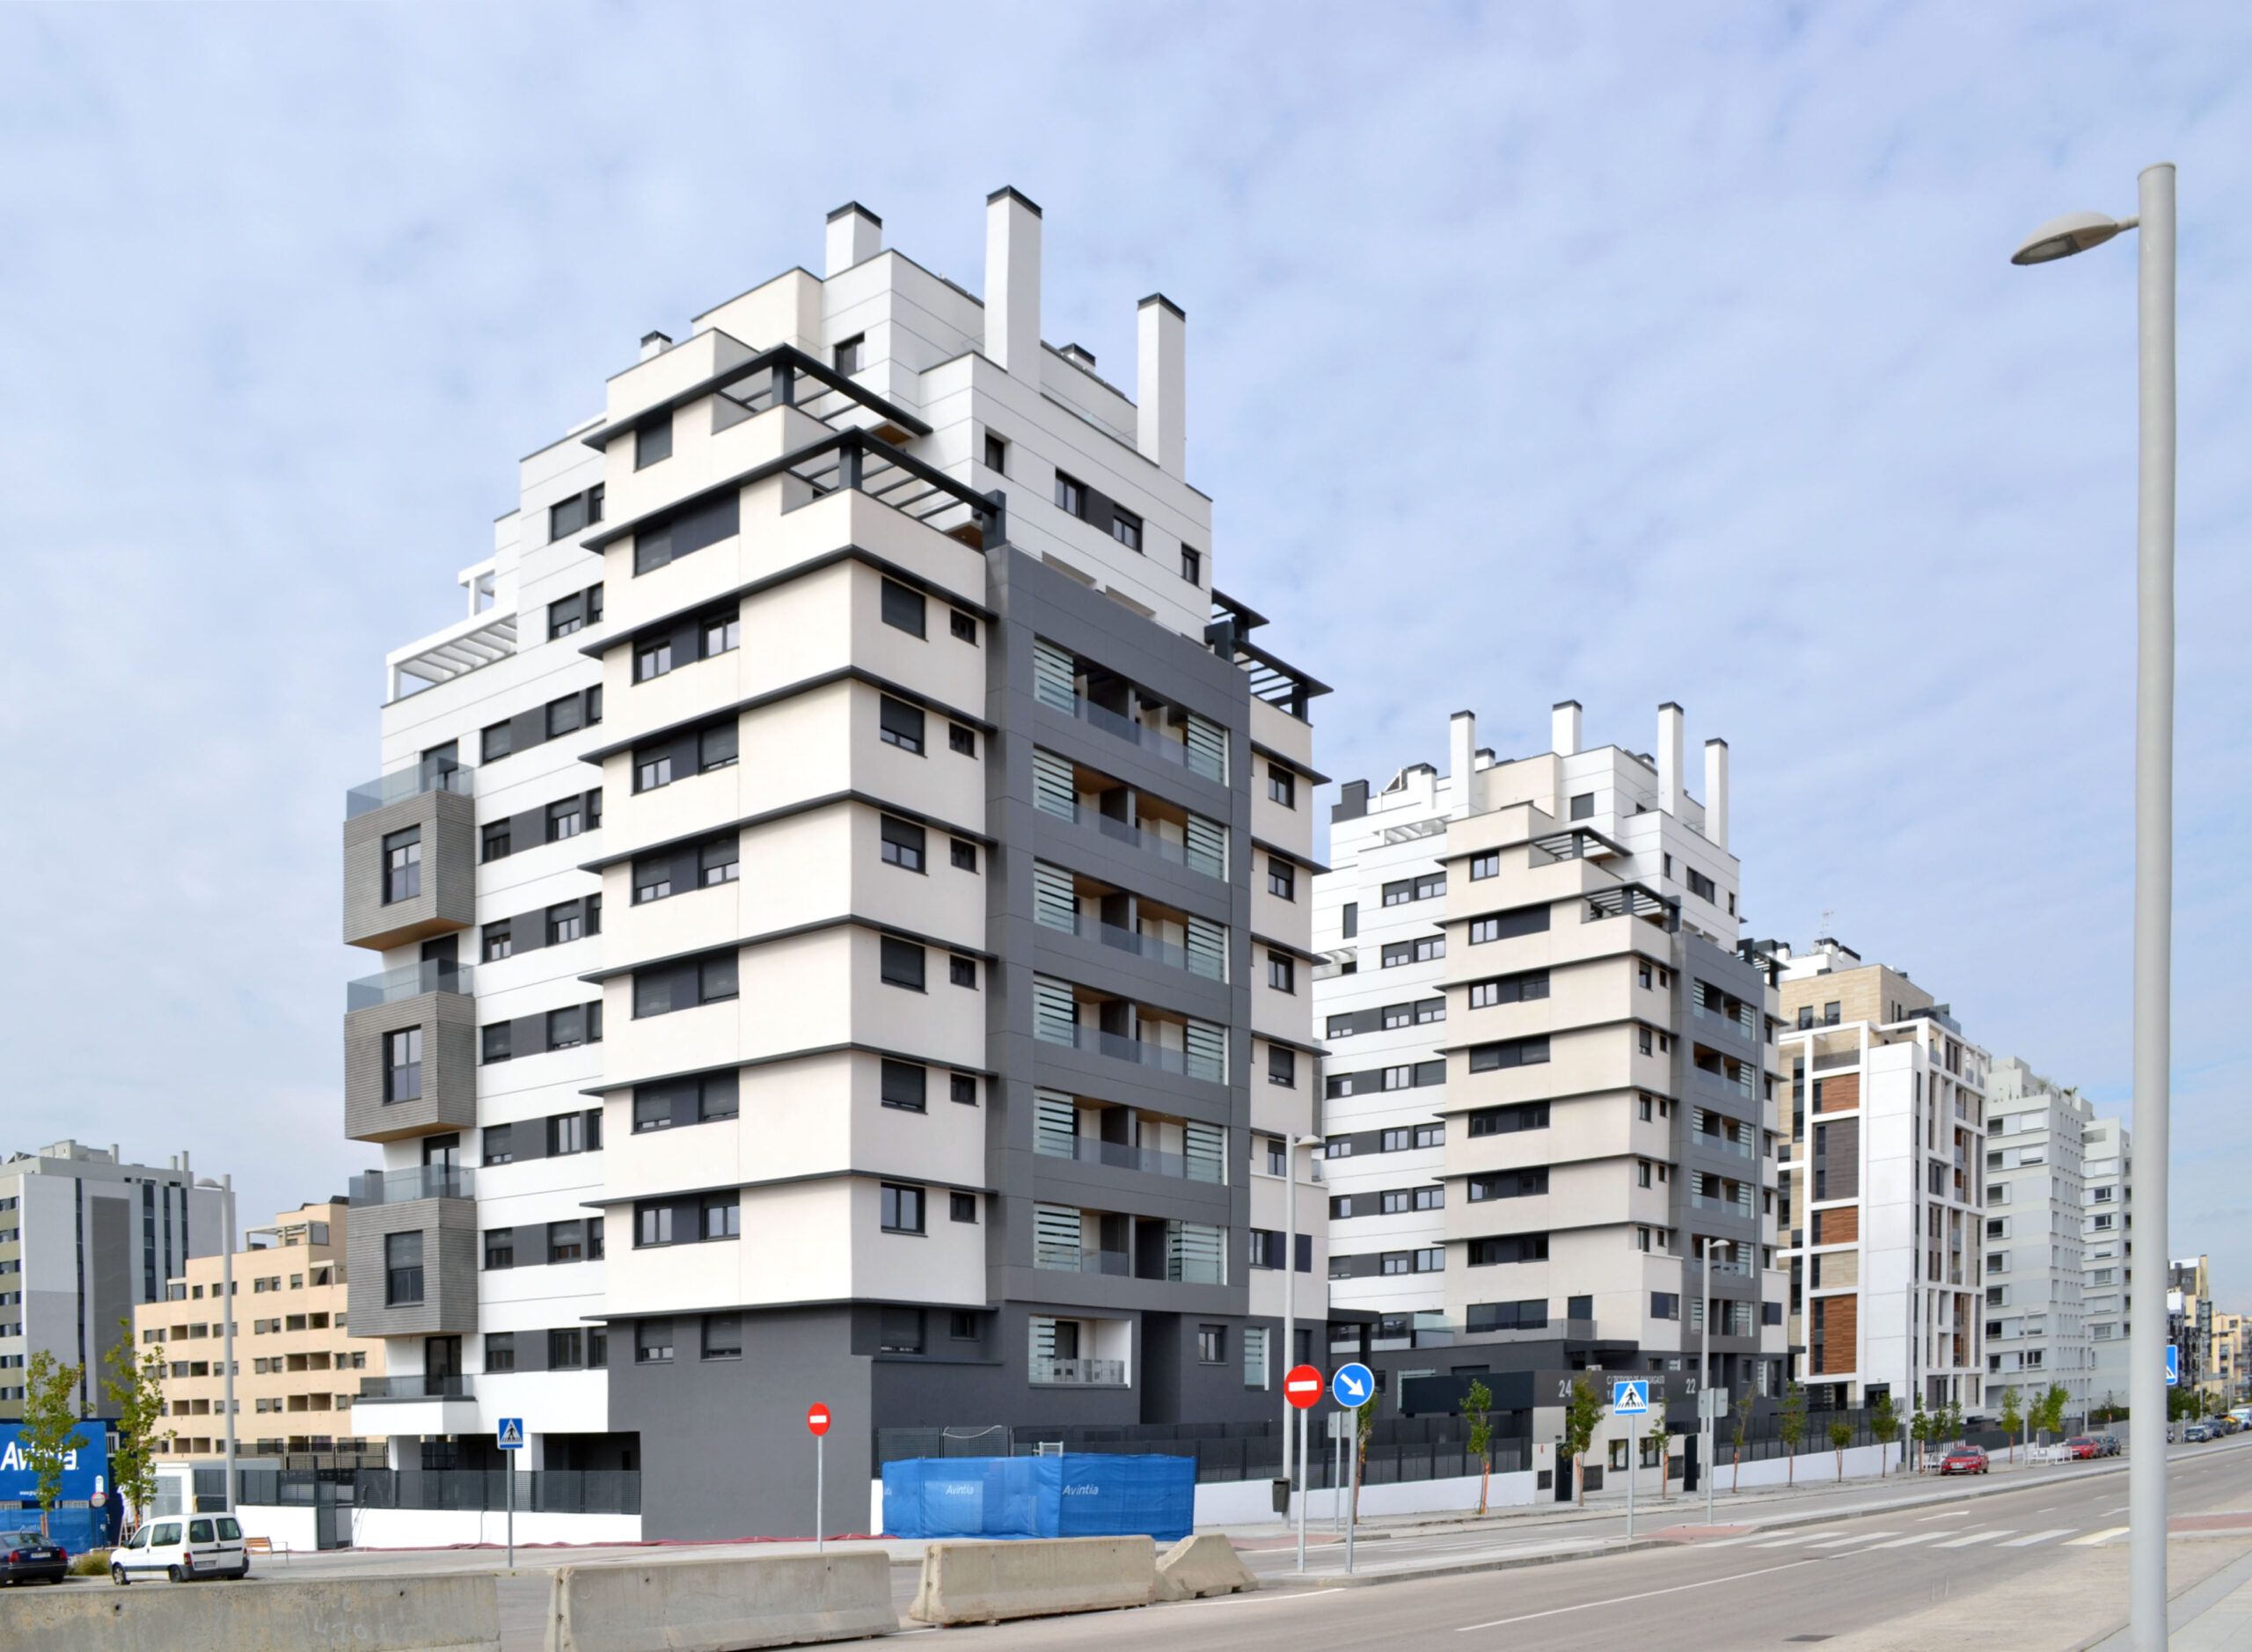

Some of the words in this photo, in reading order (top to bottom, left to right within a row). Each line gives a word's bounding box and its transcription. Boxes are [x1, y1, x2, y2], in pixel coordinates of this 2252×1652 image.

[1558, 1379, 1572, 1398] 24
[1685, 1378, 1696, 1394] 22
[946, 1484, 975, 1495] Avintia
[1062, 1484, 1099, 1495] Avintia
